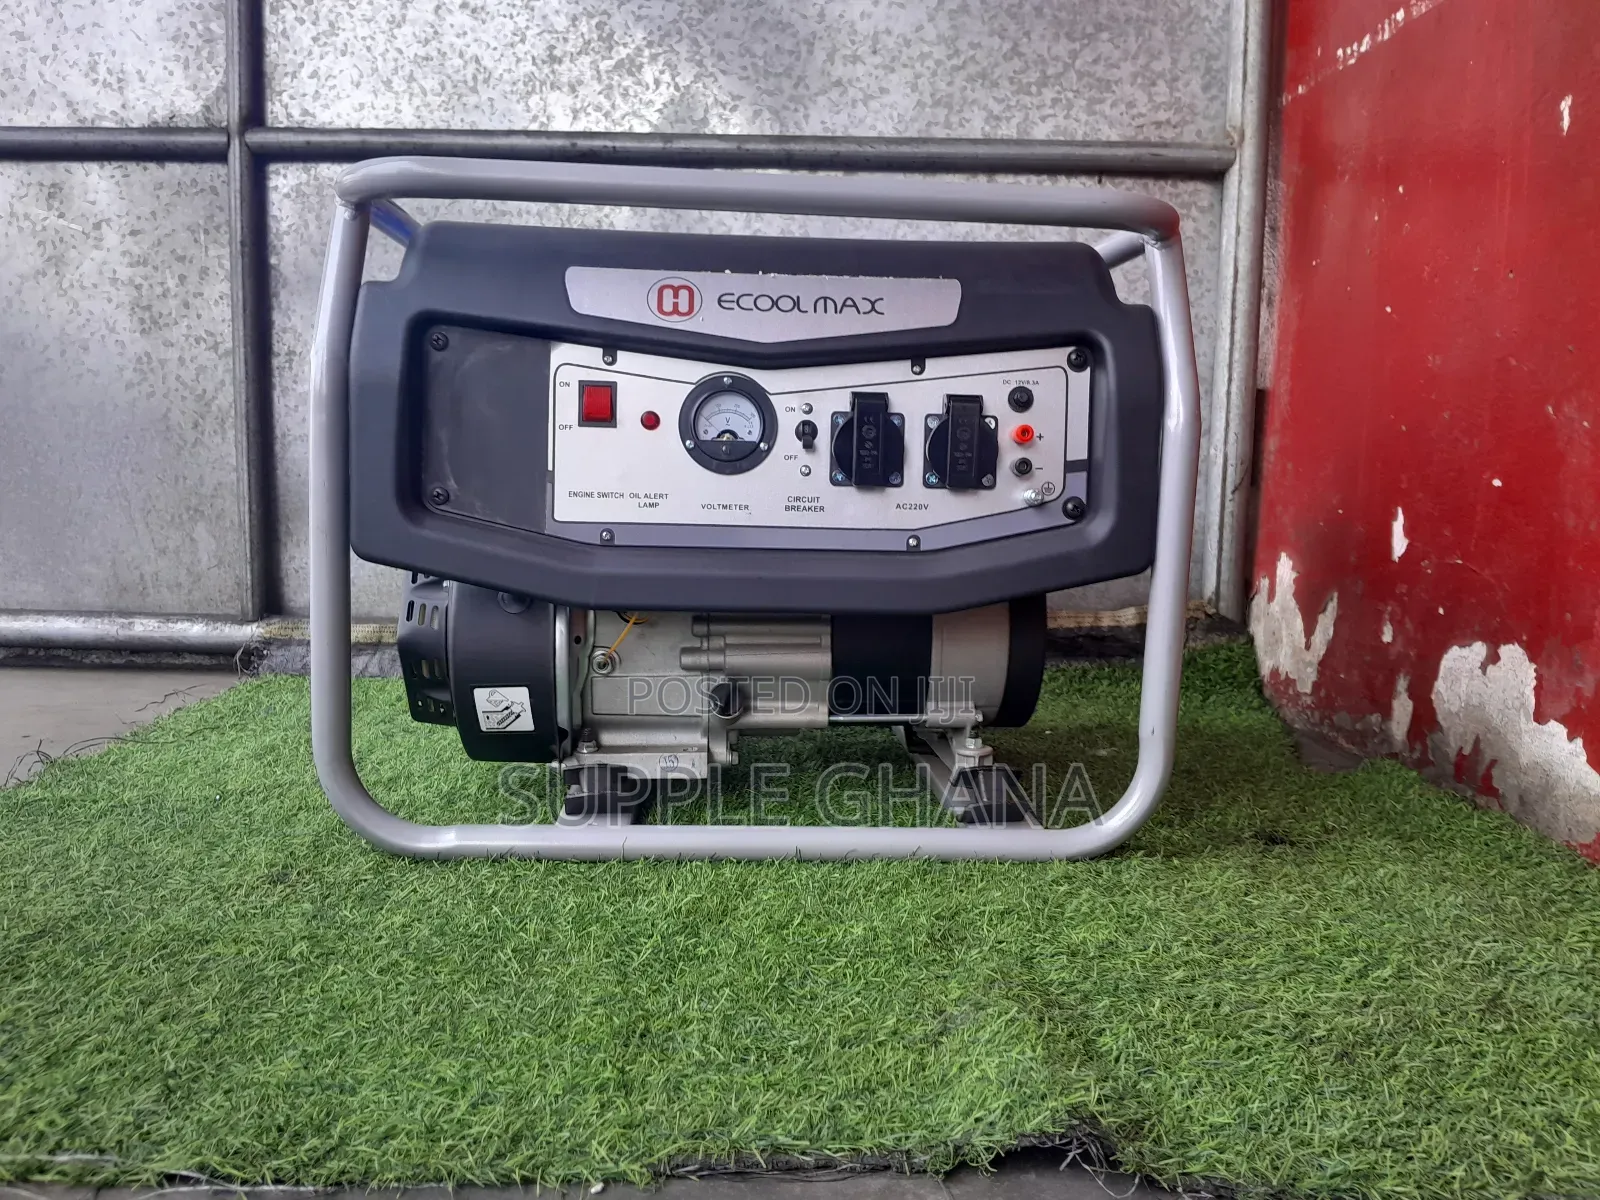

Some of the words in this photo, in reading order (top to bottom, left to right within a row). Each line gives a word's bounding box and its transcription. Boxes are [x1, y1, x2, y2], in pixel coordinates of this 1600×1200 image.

[717, 292, 808, 313] ECOOL
[814, 296, 885, 315] MAX
[725, 416, 731, 424] V
[568, 490, 595, 499] ENGINE
[597, 491, 625, 500] SWITCH
[628, 492, 642, 500] OIL
[643, 492, 669, 501] ALERT
[701, 504, 750, 512] VOLTMETER
[784, 505, 825, 513] BREAKER
[895, 502, 929, 511] AC220V
